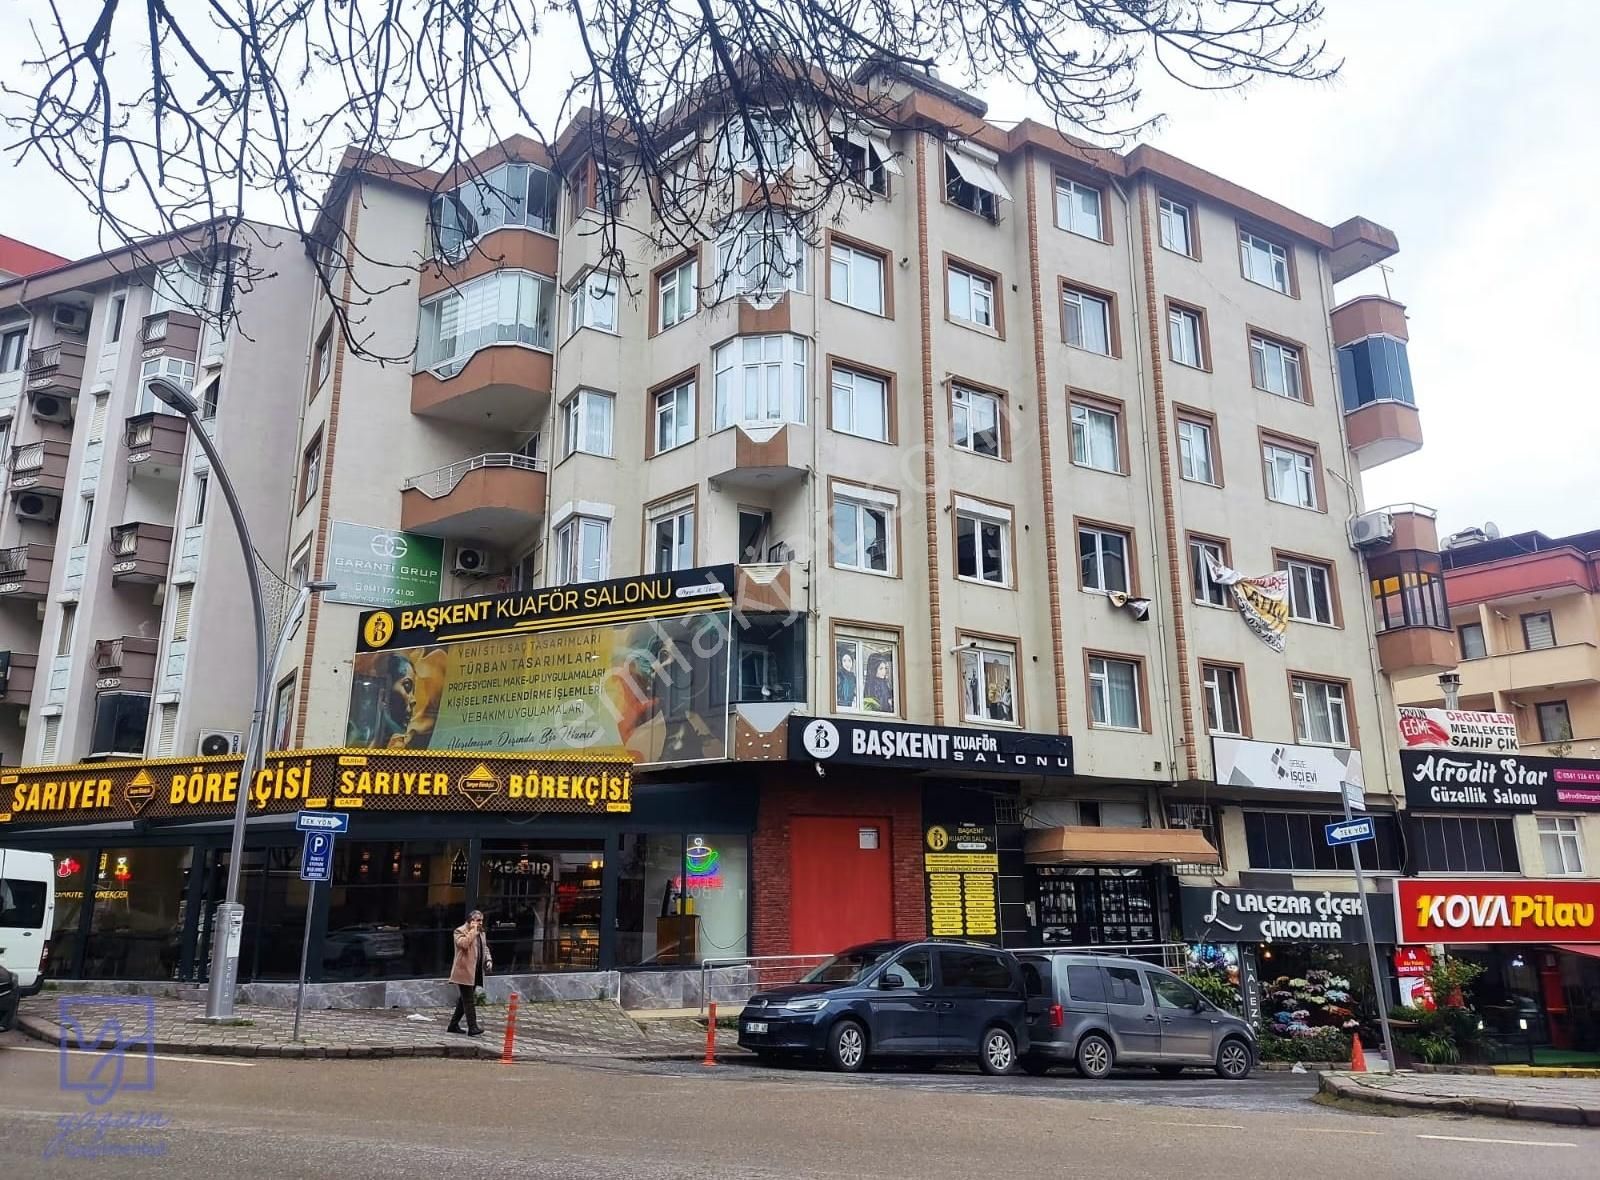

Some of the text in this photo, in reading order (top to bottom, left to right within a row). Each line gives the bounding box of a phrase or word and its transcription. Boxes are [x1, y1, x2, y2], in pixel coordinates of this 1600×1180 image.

[400, 566, 438, 578] GRUP
[401, 578, 672, 632] BAŞKENT KUAFÖR SALONU
[458, 645, 482, 658] YENİ
[530, 634, 600, 650] TASARIMLARI
[460, 651, 598, 676] TÜRBAN TASARIMLARI
[448, 669, 606, 692] PROFESYONEL MAKE-UP UYGULAMALARI
[448, 684, 604, 708] KİŞİSEL RENKLENDİRME İŞLEMLERİ
[462, 702, 584, 724] VE BAKIM UYGULAMALARI
[539, 727, 557, 744] Bir
[1450, 724, 1515, 736] MEMLEKETE
[852, 728, 997, 760] BAŞKENT KUAFÖR
[1451, 735, 1518, 751] SAHİP ÇIK
[954, 752, 1068, 767] SALONU
[1412, 755, 1548, 786] Afrodit Star
[12, 759, 312, 812] SARIYER BÖREÇİSİ
[340, 770, 630, 805] SARIYER BÖREKÇİSİ
[1431, 786, 1538, 805] Güzellik Salonu
[1355, 826, 1368, 834] YÖN
[314, 837, 324, 852] P
[1236, 890, 1363, 922] LALEZAR ÇİÇEK
[1260, 914, 1342, 944] ÇİKOLATA
